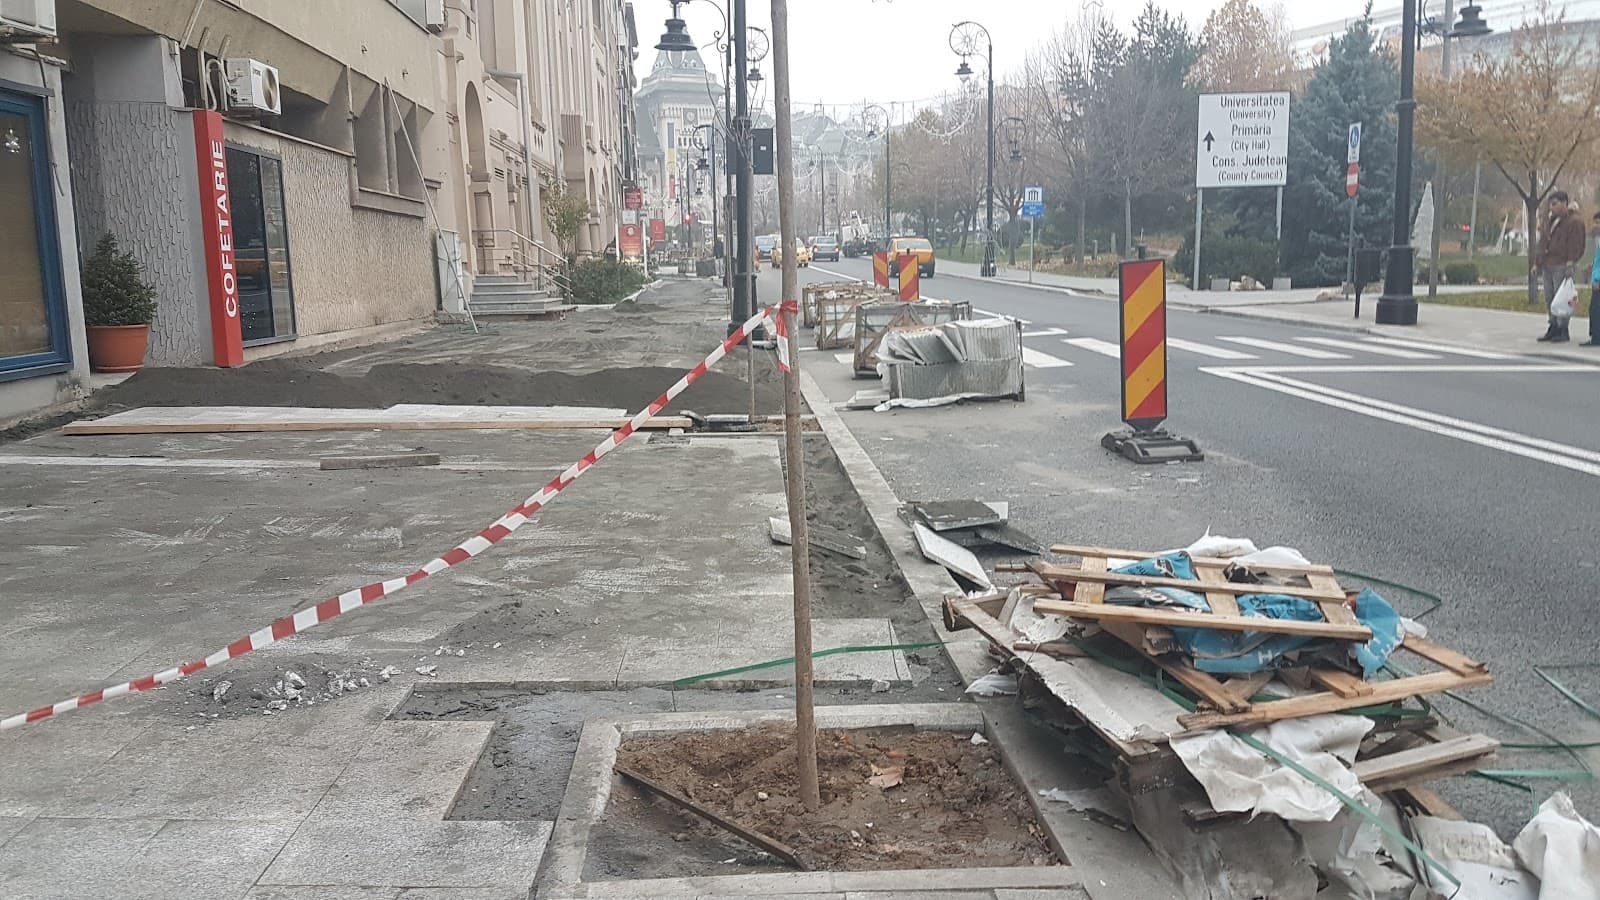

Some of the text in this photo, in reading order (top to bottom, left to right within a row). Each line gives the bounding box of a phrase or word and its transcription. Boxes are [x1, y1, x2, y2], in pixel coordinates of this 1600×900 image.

[1221, 95, 1285, 108] Universitatea
[1229, 108, 1276, 121] (University)
[1231, 139, 1270, 152] (City Hall)
[1212, 155, 1239, 167] Cons.
[1218, 168, 1283, 184] (County Council)
[212, 140, 237, 318] COFETARIE
